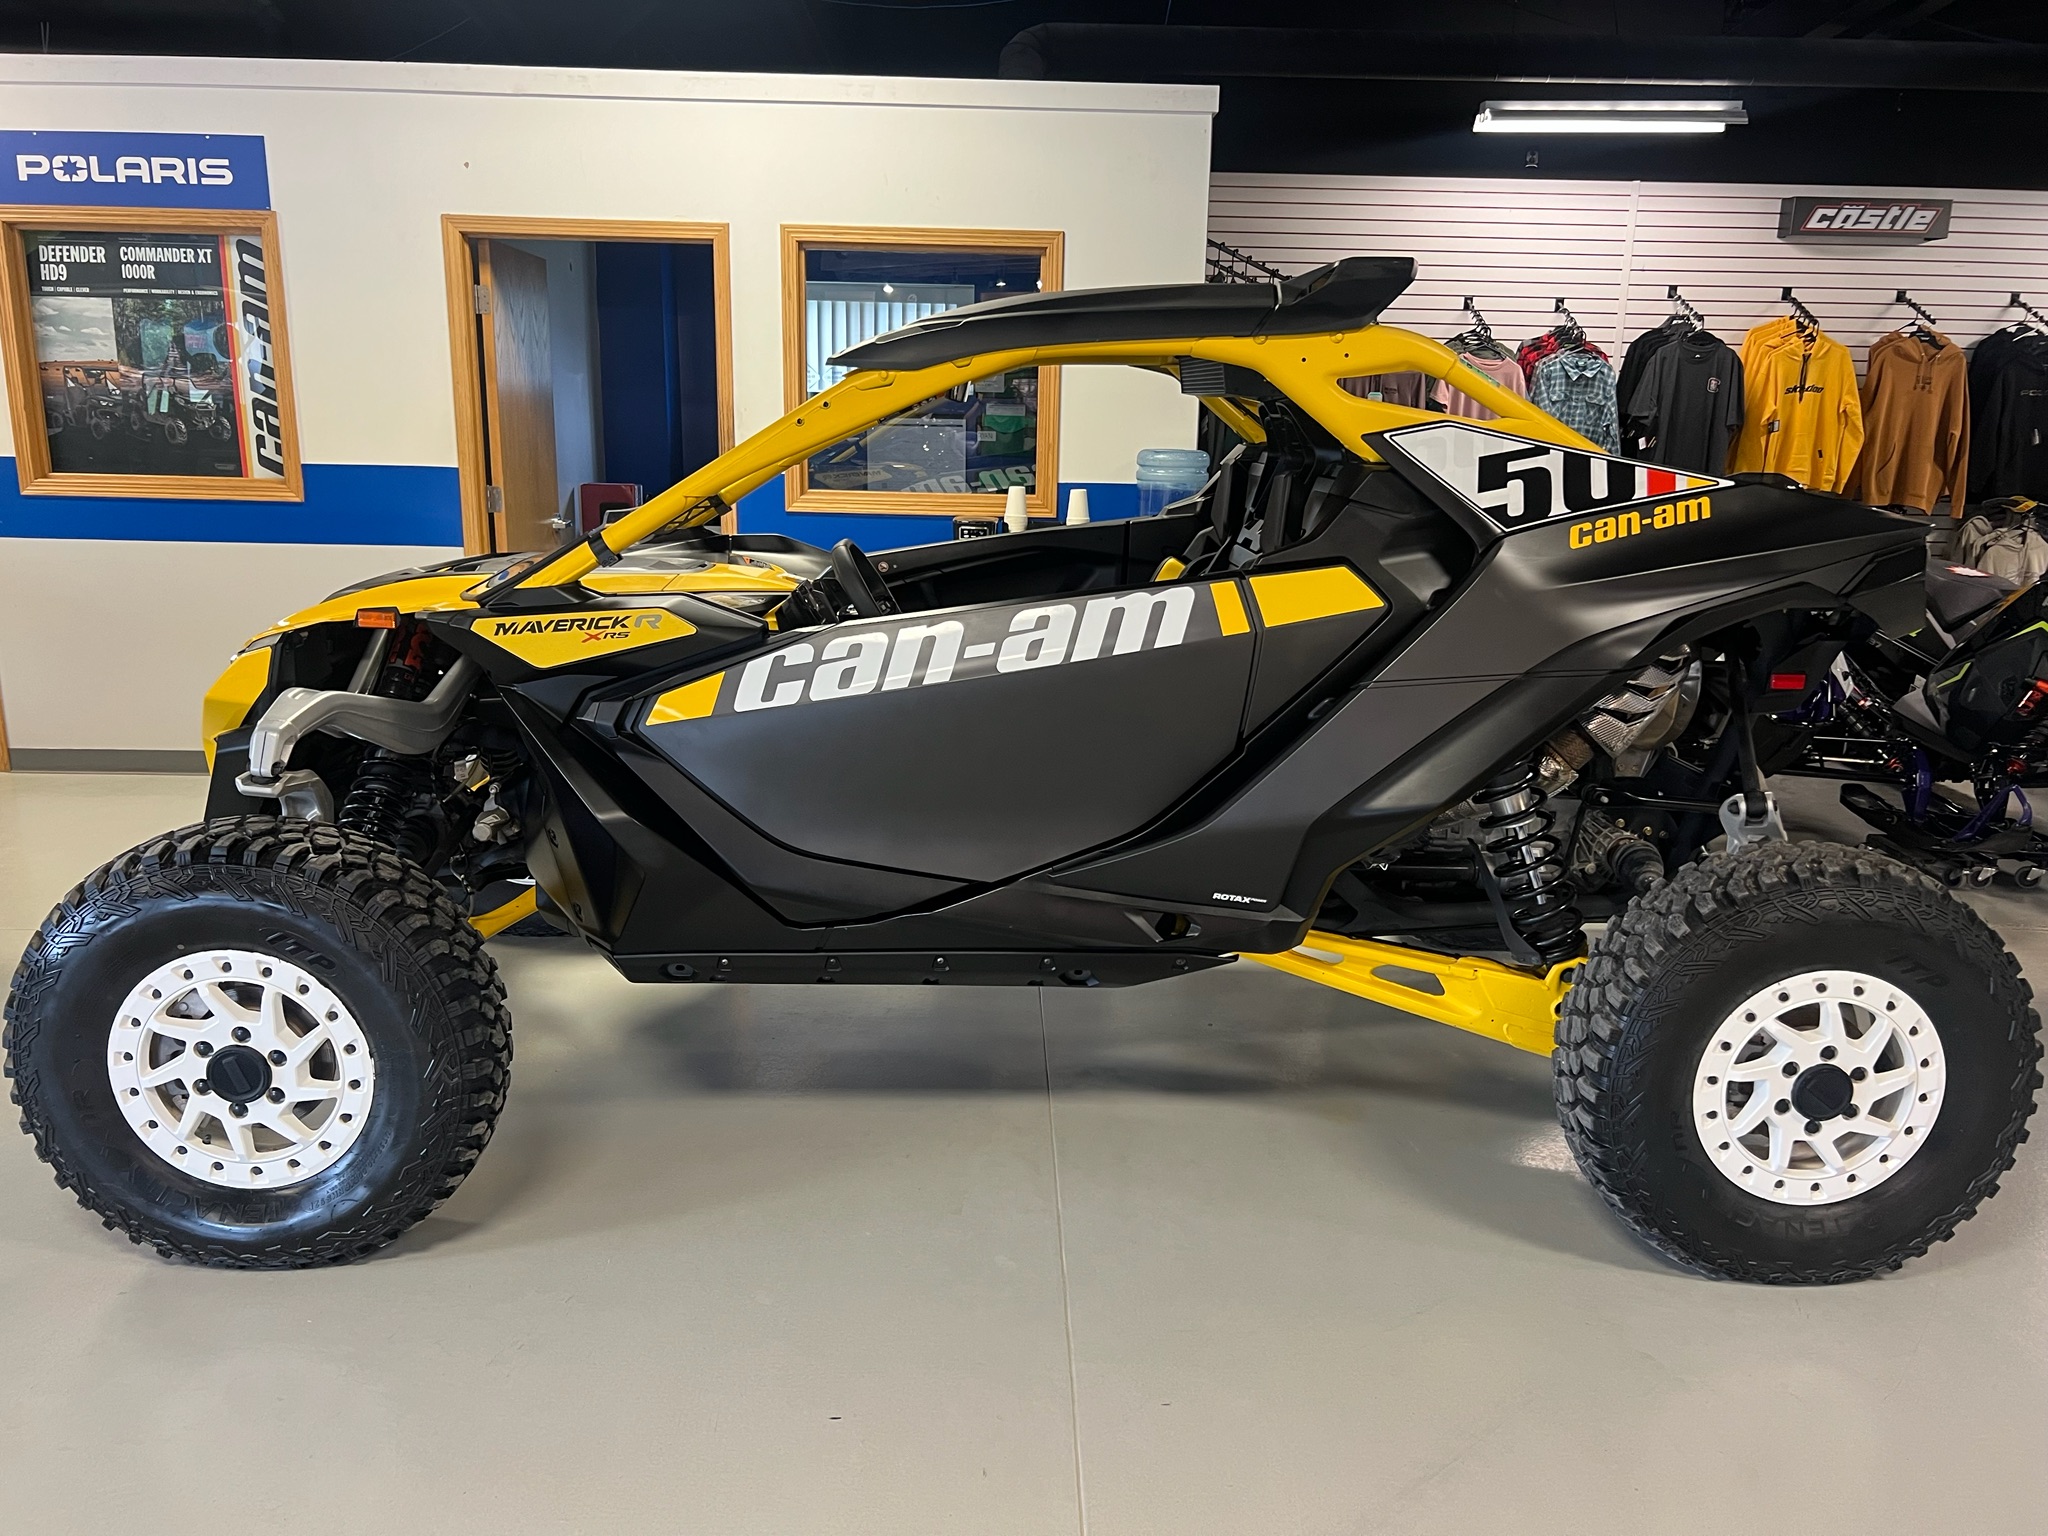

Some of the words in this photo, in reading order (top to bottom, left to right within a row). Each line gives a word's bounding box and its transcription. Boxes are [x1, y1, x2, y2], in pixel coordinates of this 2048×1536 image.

[16, 154, 234, 186] POLARIS
[38, 245, 107, 263] DEFENDER
[119, 246, 195, 263] COMMANDER
[197, 248, 213, 264] XT
[40, 263, 68, 281] HD9
[121, 264, 156, 280] 1000R
[236, 239, 285, 477] can-am
[1569, 495, 1712, 550] can-am
[494, 615, 632, 637] MAVERICK
[634, 614, 663, 629] R
[581, 630, 631, 644] XRS
[733, 586, 1196, 713] can-am
[1212, 892, 1251, 904] ROTAX
[265, 931, 336, 971] ITP
